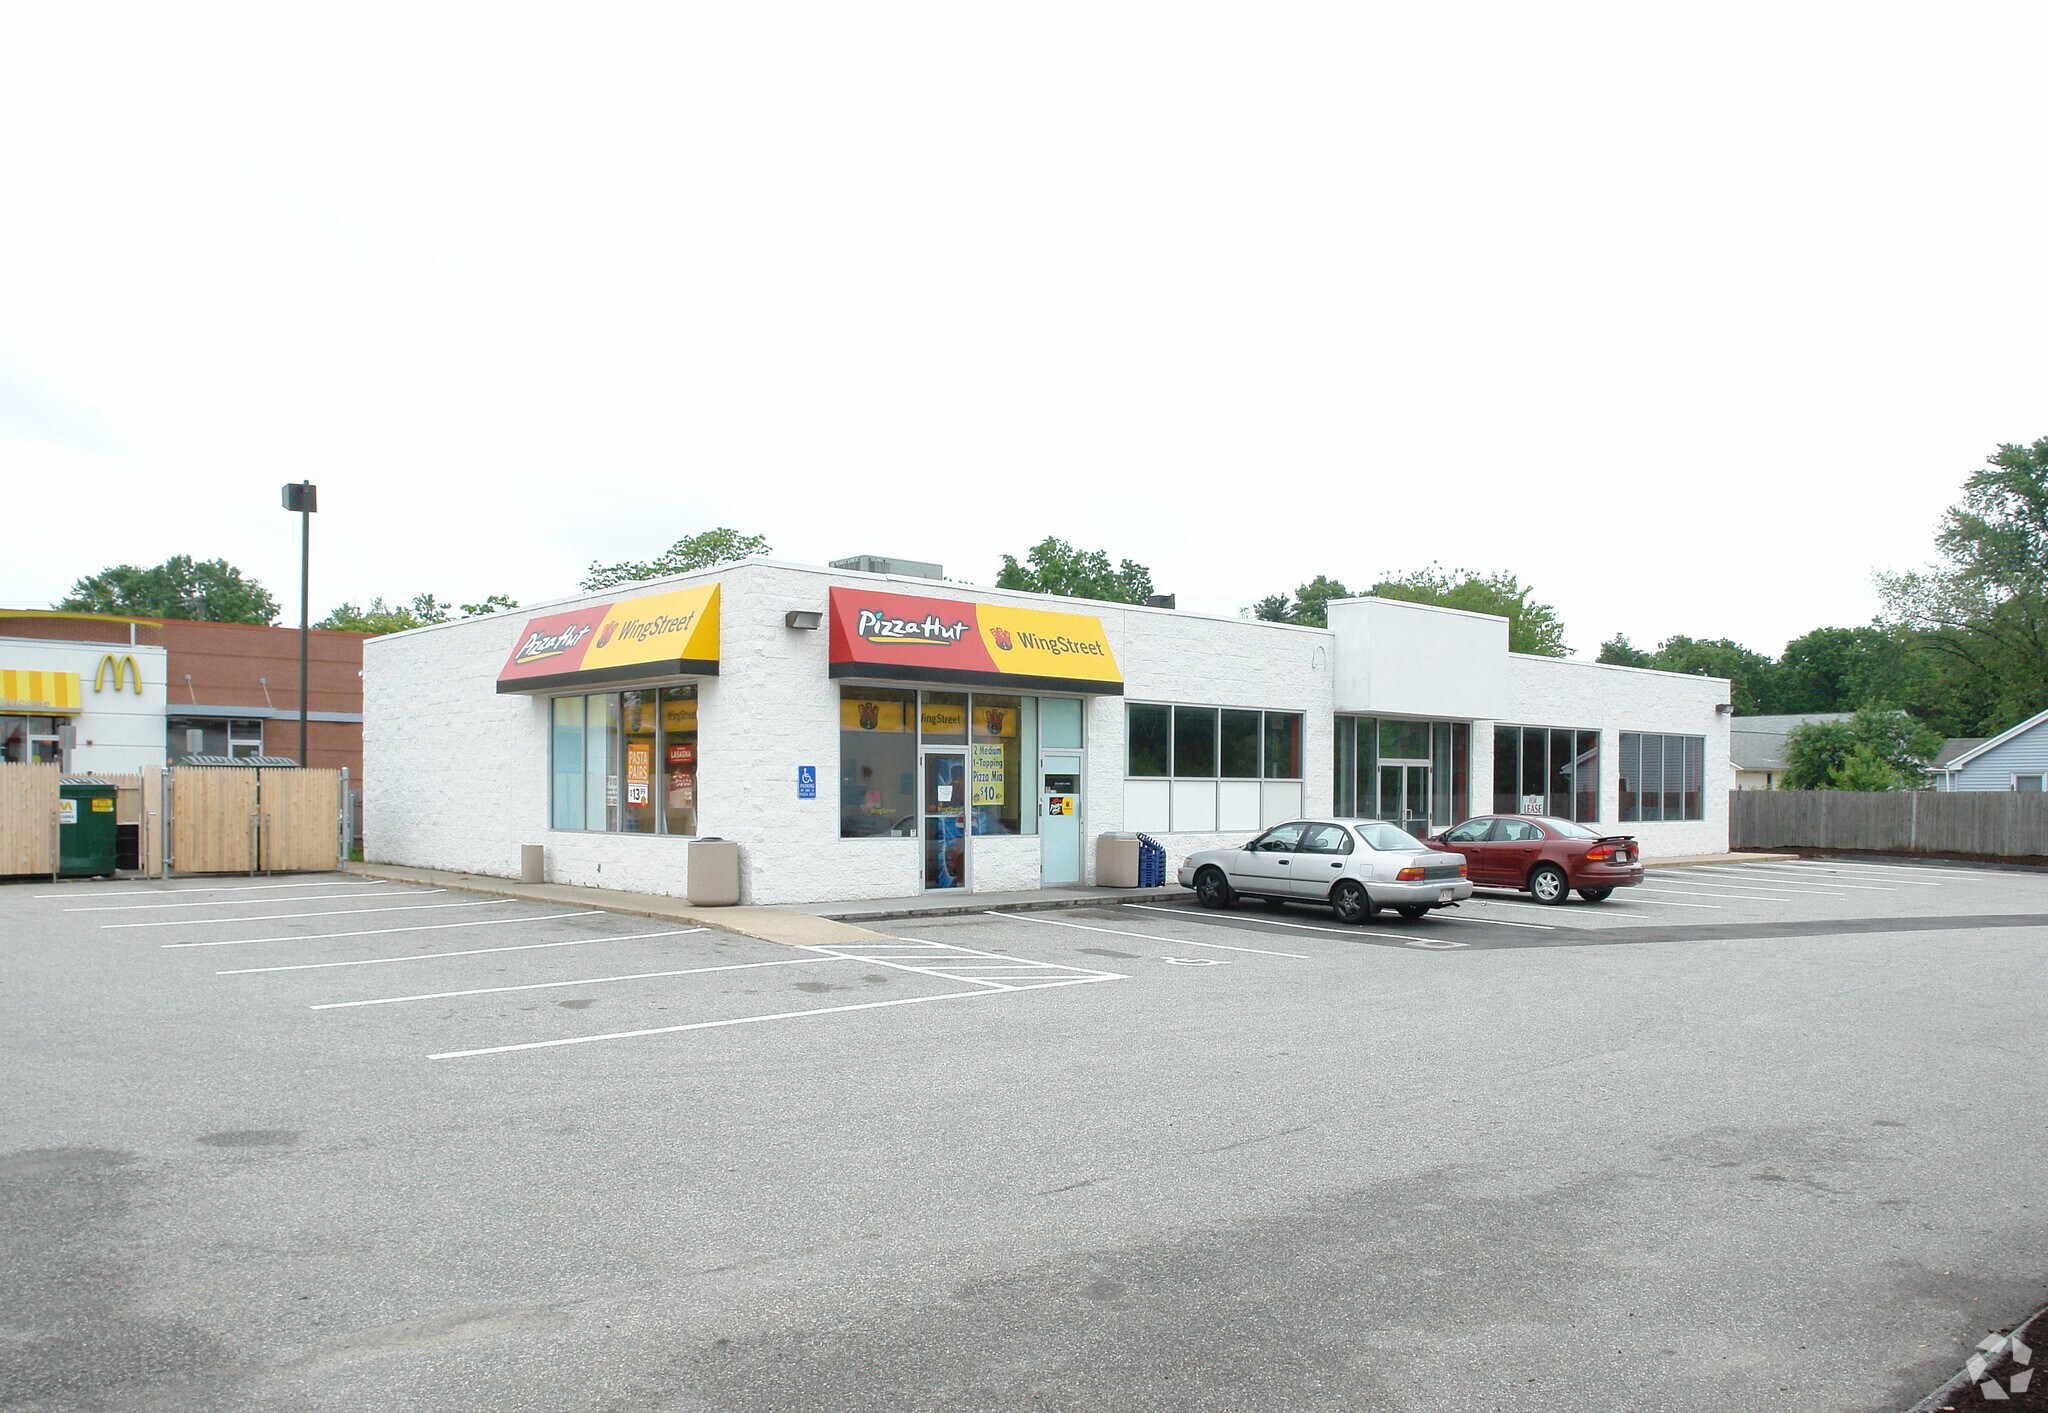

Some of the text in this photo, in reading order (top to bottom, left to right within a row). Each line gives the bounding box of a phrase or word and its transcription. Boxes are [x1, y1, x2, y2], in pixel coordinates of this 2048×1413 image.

[618, 610, 695, 642] WingStreet
[858, 610, 969, 640] Pizza Hut
[515, 624, 591, 659] Pizza Hut
[1017, 631, 1105, 656] WingStreet
[671, 751, 691, 759] LASAGNA
[974, 746, 1001, 755] 2 Medium
[629, 751, 648, 765] PASTA
[973, 758, 1002, 769] 1-Topping
[629, 766, 648, 780] PAIRS
[973, 771, 1002, 782] Pizza Mia
[980, 786, 995, 800] $10
[1524, 804, 1542, 813] LEASE
